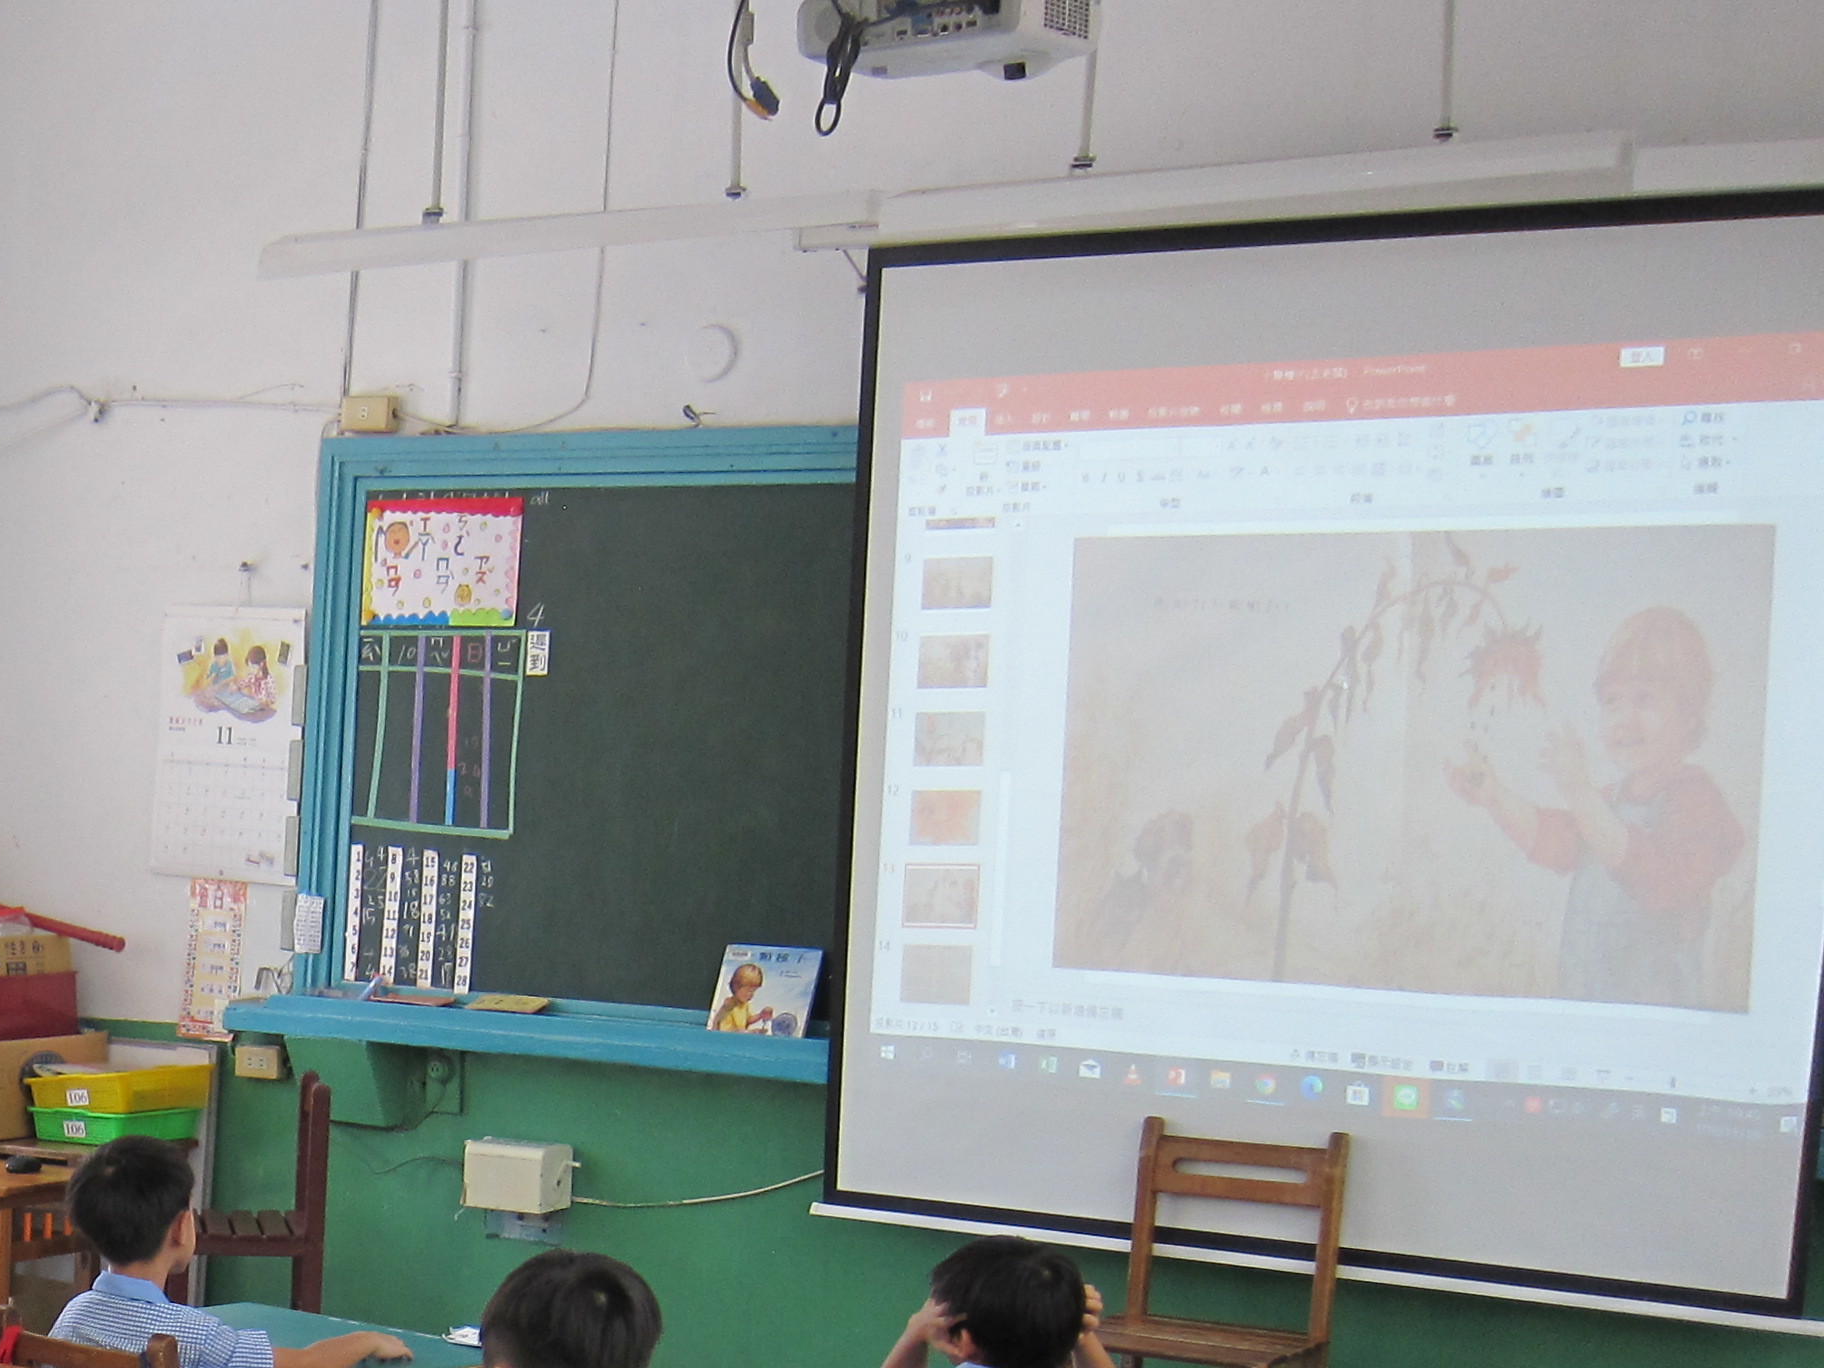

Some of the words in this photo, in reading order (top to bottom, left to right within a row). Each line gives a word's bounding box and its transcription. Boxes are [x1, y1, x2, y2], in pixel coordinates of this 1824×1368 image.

[216, 726, 233, 745] 11
[391, 853, 397, 864] 8
[425, 857, 435, 868] 15
[464, 861, 474, 872] 22
[424, 875, 435, 887] 16
[463, 881, 473, 892] 23
[388, 891, 398, 902] 10
[423, 894, 434, 906] 17
[462, 900, 473, 911] 24
[387, 910, 397, 920] 11
[422, 913, 433, 924] 18
[461, 918, 471, 930] 25
[385, 928, 396, 939] 12
[421, 932, 431, 943] 19
[460, 937, 470, 948] 26
[383, 947, 394, 957] 13
[420, 950, 430, 961] 20
[458, 956, 469, 967] 27
[382, 964, 392, 975] 14
[419, 969, 429, 980] 21
[457, 975, 467, 986] 28
[68, 1092, 87, 1105] 106
[65, 1123, 84, 1136] 106
